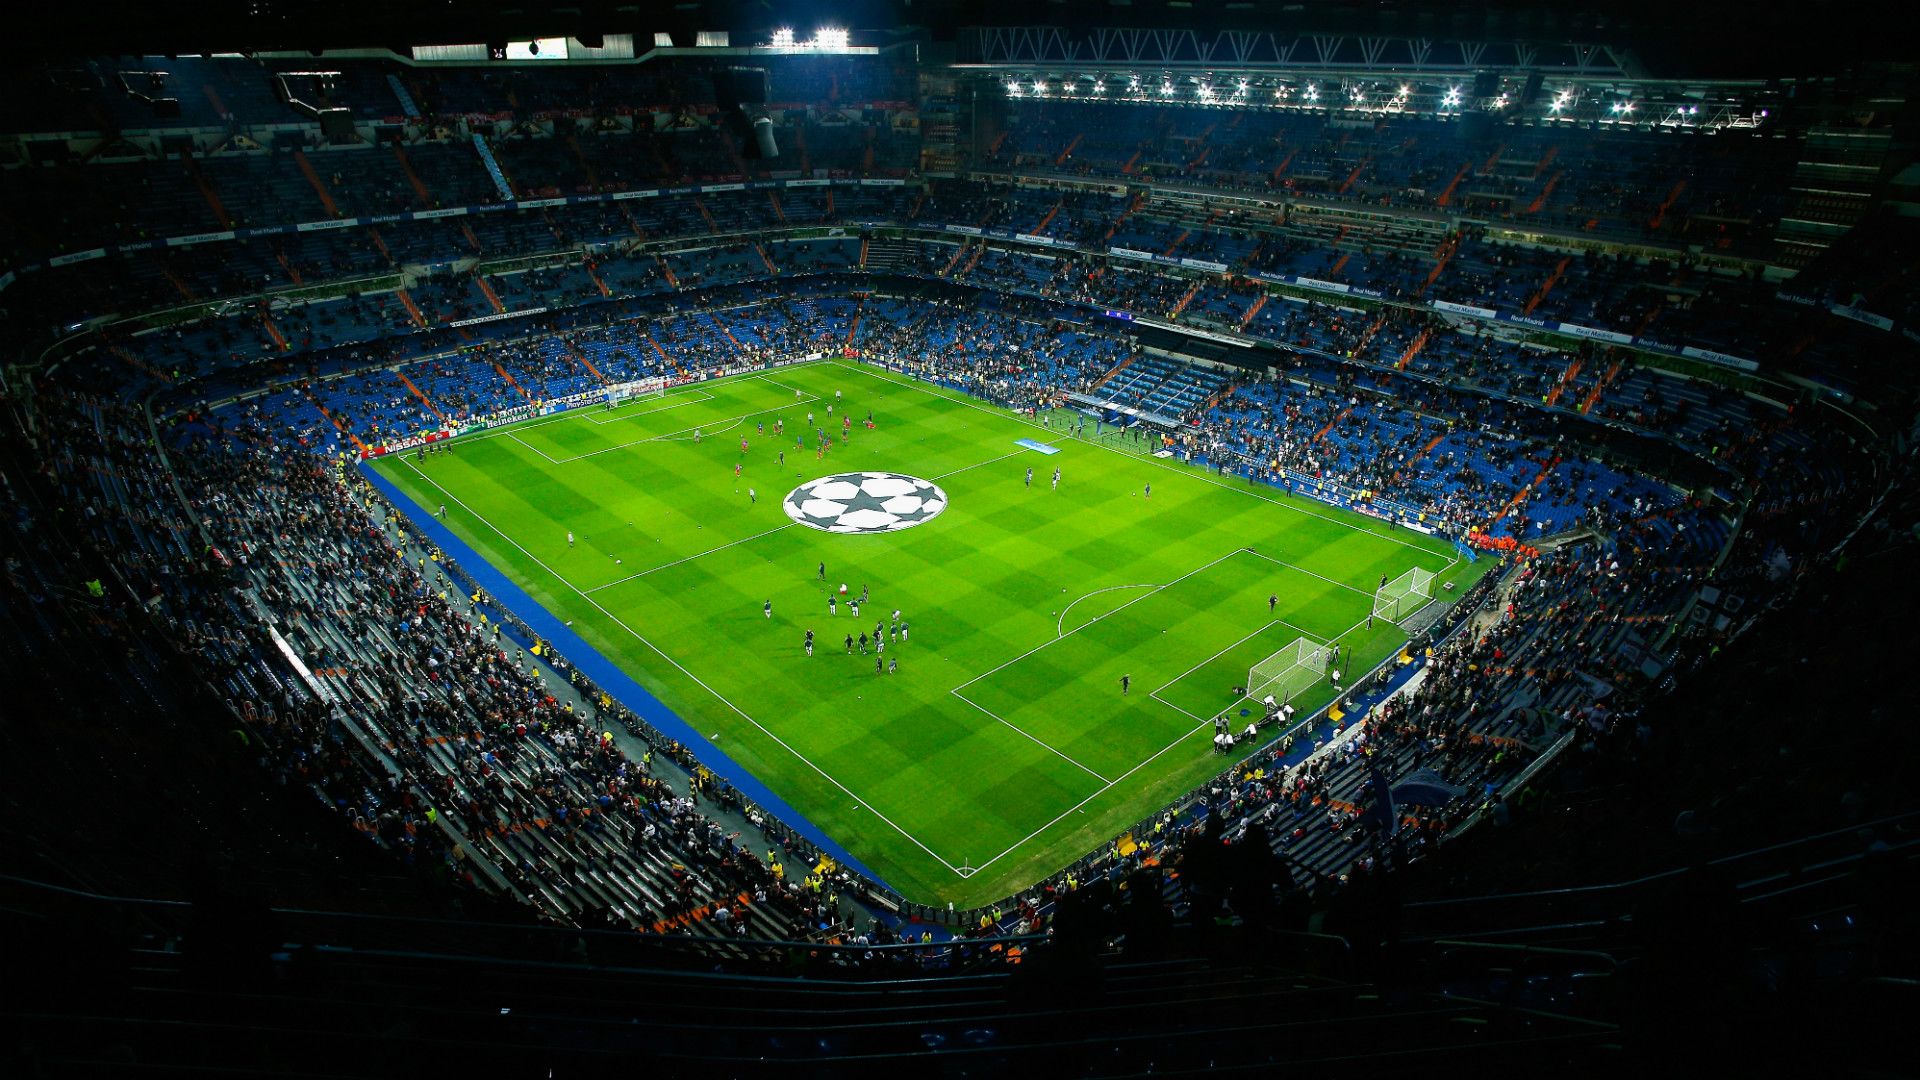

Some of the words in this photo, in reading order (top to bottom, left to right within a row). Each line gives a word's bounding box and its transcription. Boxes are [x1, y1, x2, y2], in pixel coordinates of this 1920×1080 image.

[1363, 287, 1382, 296] Madrid
[1792, 295, 1816, 306] Madrid
[1461, 307, 1482, 315] Madrid
[1510, 314, 1524, 322] Real
[1524, 316, 1545, 326] Madrid
[1575, 328, 1590, 336] Real
[1590, 330, 1614, 340] Madrid
[724, 363, 766, 376] MasterCard
[486, 413, 529, 428] Heineken
[384, 437, 426, 453] NISSAN
